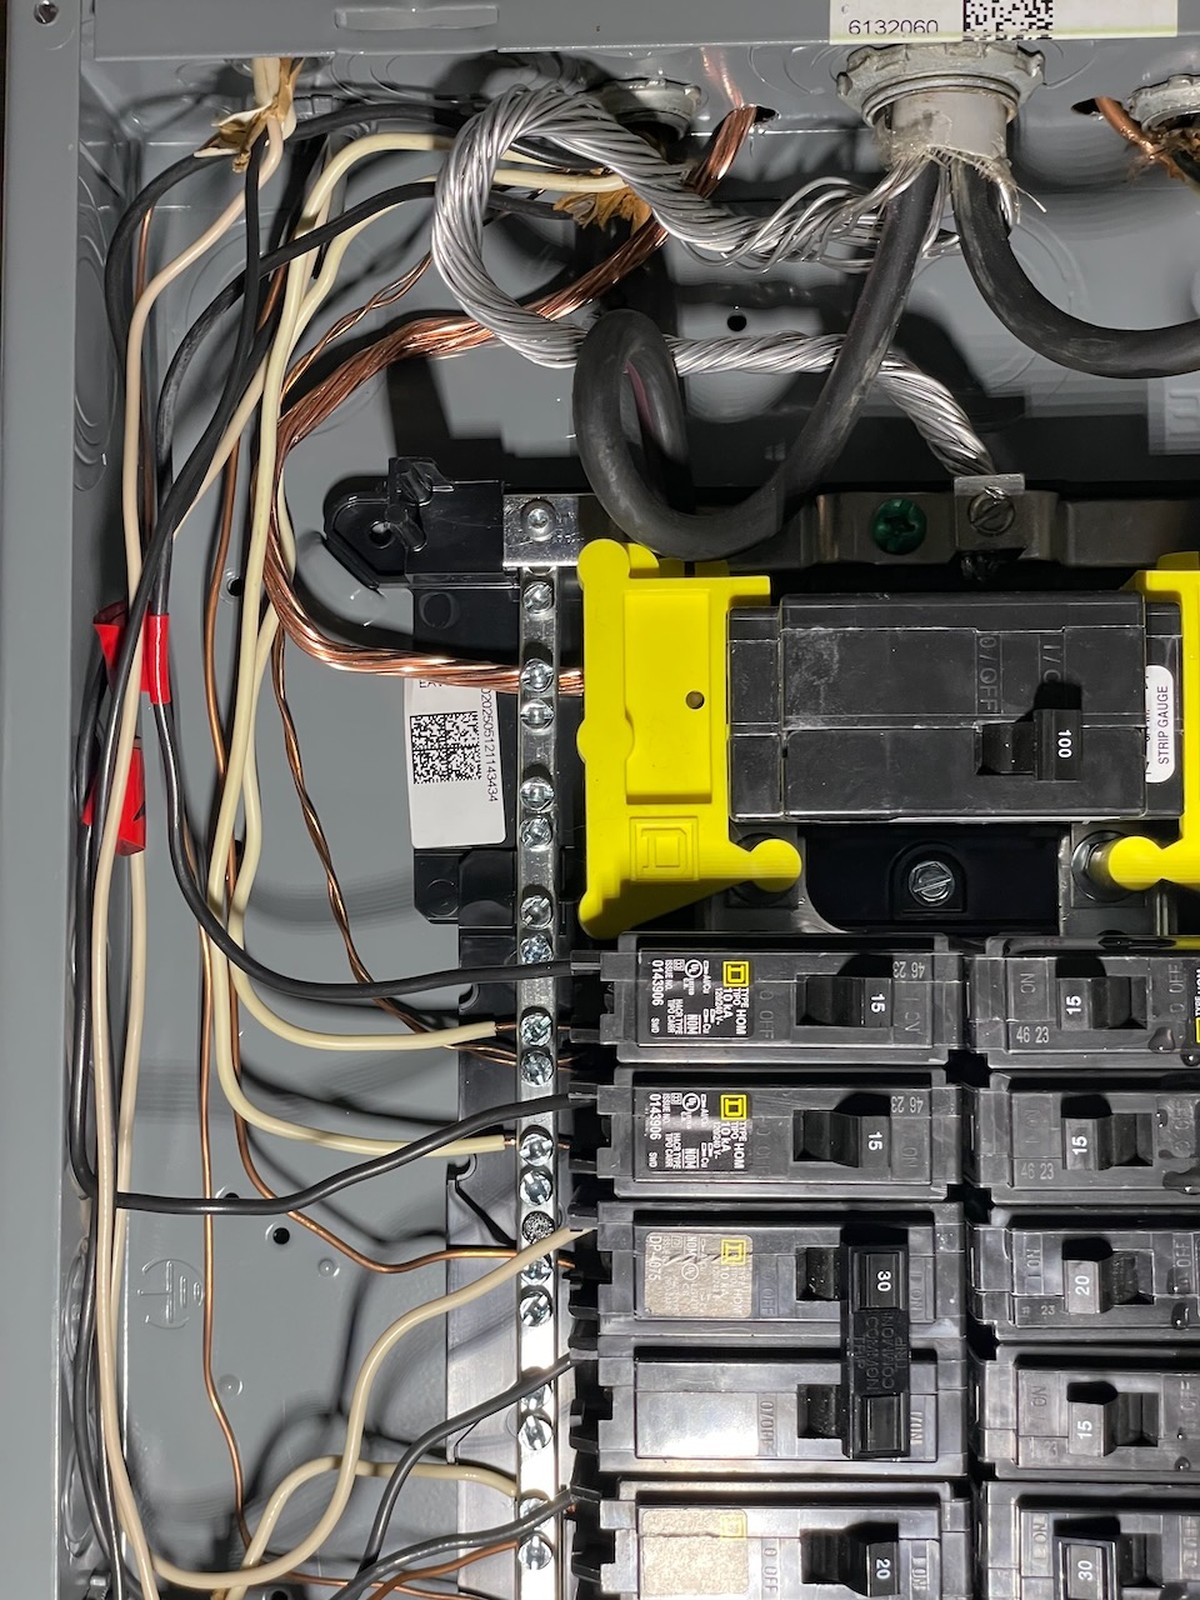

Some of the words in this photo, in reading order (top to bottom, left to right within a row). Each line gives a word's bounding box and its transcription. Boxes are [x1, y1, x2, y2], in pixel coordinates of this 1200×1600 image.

[848, 19, 939, 35] 6132060
[1157, 686, 1168, 727] GAUGE
[1058, 730, 1071, 758] 100
[1158, 731, 1169, 765] STRIP
[892, 961, 906, 978] 23
[911, 961, 926, 979] 46
[652, 960, 663, 1006] 0143906
[724, 988, 731, 1001] 10
[741, 988, 749, 1008] TYPE
[871, 993, 885, 1013] 15
[724, 1004, 733, 1018] kA
[1066, 995, 1082, 1015] 15
[651, 1017, 659, 1033] SWD
[687, 1014, 699, 1034] NOM
[703, 1023, 711, 1033] Cu
[736, 1009, 746, 1034] HOM
[1016, 1026, 1030, 1043] 46
[1035, 1026, 1049, 1043] 23
[890, 1095, 903, 1113] 23
[909, 1096, 923, 1113] 46
[650, 1093, 661, 1139] 0143906
[721, 1122, 729, 1135] 10
[868, 1131, 882, 1151] 15
[1072, 1135, 1088, 1155] 15
[684, 1148, 696, 1168] NOM
[733, 1143, 743, 1168] HOM
[1040, 1162, 1054, 1180] 23
[1177, 1242, 1191, 1268] OFF
[877, 1271, 891, 1291] 30
[1075, 1275, 1090, 1296] 20
[1033, 1385, 1048, 1407] ON
[1078, 1420, 1092, 1440] 15
[1033, 1523, 1047, 1544] ON
[875, 1558, 890, 1579] 20
[1078, 1560, 1093, 1581] 30
[763, 1566, 778, 1592] OFF
